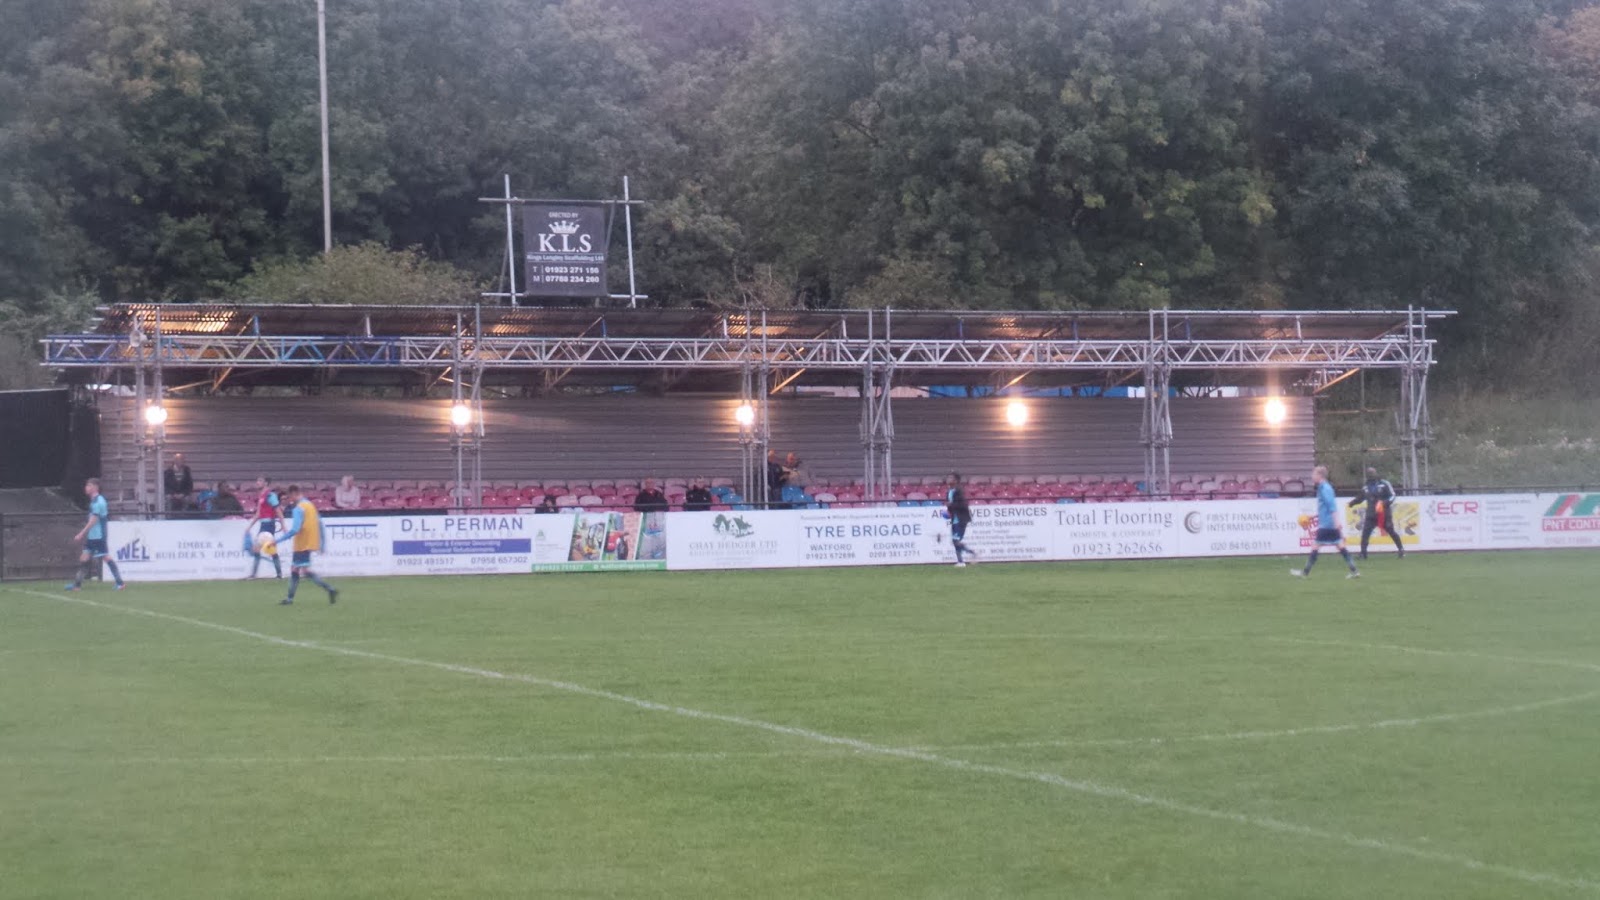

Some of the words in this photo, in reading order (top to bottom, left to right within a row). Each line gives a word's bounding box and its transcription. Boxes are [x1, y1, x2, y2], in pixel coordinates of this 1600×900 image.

[538, 232, 592, 253] K.L.S
[994, 507, 1047, 517] SERVICES
[1436, 500, 1479, 515] ECR
[994, 519, 1034, 527] Specialists
[1055, 509, 1096, 526] Total
[1104, 508, 1173, 528] Flooring
[1206, 513, 1229, 521] FIRST
[1232, 512, 1277, 521] FINANCIAL
[444, 517, 523, 531] PERMAN
[1207, 522, 1280, 532] INTERMEDIARIES
[1281, 521, 1297, 530] LTD
[1544, 519, 1565, 530] PNT
[332, 527, 379, 540] Hobbs
[804, 525, 845, 538] TYRE
[851, 524, 922, 537] BRIGADE
[116, 538, 150, 560] WEL
[1072, 543, 1112, 555] 01923
[1116, 542, 1163, 554] 262656
